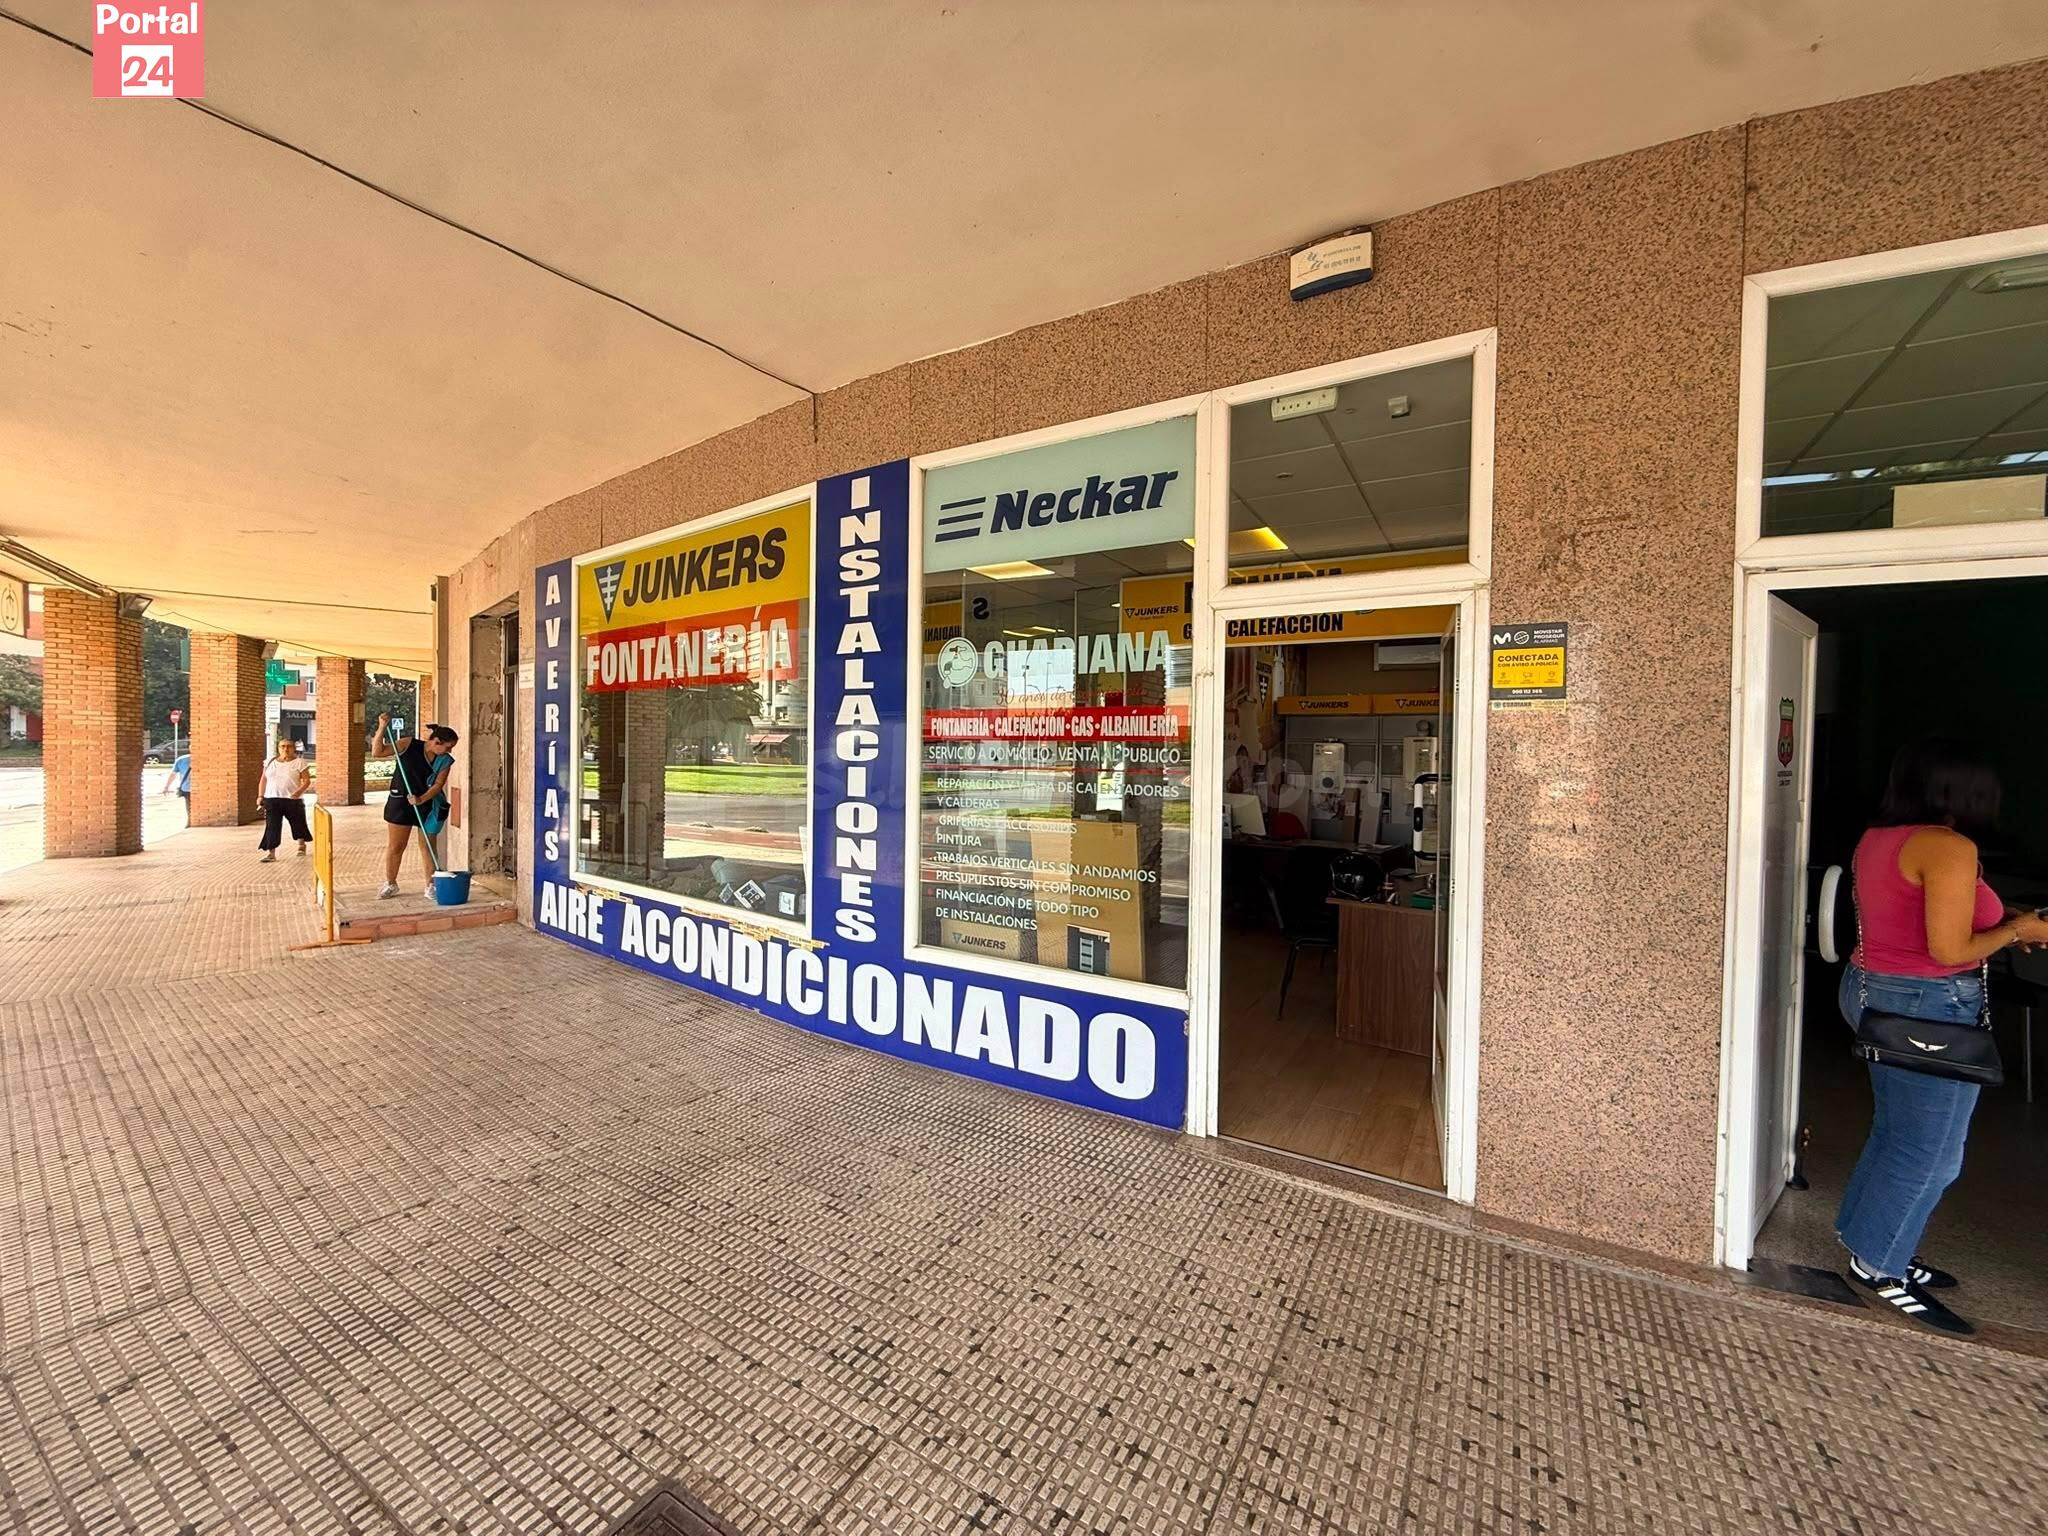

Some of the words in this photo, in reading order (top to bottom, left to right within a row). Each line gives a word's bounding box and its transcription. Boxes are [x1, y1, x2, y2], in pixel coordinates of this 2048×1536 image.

[990, 470, 1179, 534] Neckar
[623, 527, 787, 607] JUNKERS
[1135, 605, 1179, 616] JUNKERS
[1228, 612, 1344, 638] CALEFACCIÓN
[587, 605, 793, 687] FONTANERÍA
[984, 630, 1170, 679] GIANA
[1497, 654, 1559, 662] CONECTADA
[836, 475, 882, 943] INSTALACIONES
[1308, 701, 1349, 709] JUNKERS
[1405, 699, 1440, 708] JUNKE
[545, 574, 561, 862] AVERÍAS
[931, 711, 990, 737] FONTANERÍA
[1071, 715, 1095, 737] GAS
[1099, 708, 1179, 737] ALBAÑILERÍA
[929, 745, 976, 760] SERVICIO
[978, 747, 986, 760] A
[1059, 746, 1099, 762] VENTA
[937, 797, 944, 807] Y
[946, 797, 1000, 809] CALDERAS
[1058, 782, 1073, 793] DE
[1076, 782, 1180, 798] CALENTADORES
[936, 833, 982, 847] PINTURA
[936, 851, 988, 866] TRABAJOS
[990, 857, 1056, 872] VERTICALES
[1060, 862, 1080, 875] SIN
[1083, 865, 1157, 883] ANDAMIOS
[936, 870, 1017, 889] PRESUPUESTOS
[1019, 881, 1039, 891] SIN
[1042, 882, 1131, 901] COMPROMISO
[936, 888, 1015, 908] FINANCIACIÓN
[1017, 898, 1032, 910] DE
[1036, 900, 1069, 914] TODO
[1071, 904, 1099, 918] TIPO
[936, 907, 949, 918] DE
[951, 908, 1038, 930] INSTALACIONES
[961, 935, 1006, 950] JUNKERS
[540, 880, 603, 945] AIRE
[621, 902, 1155, 1100] ACONDICIONADO
